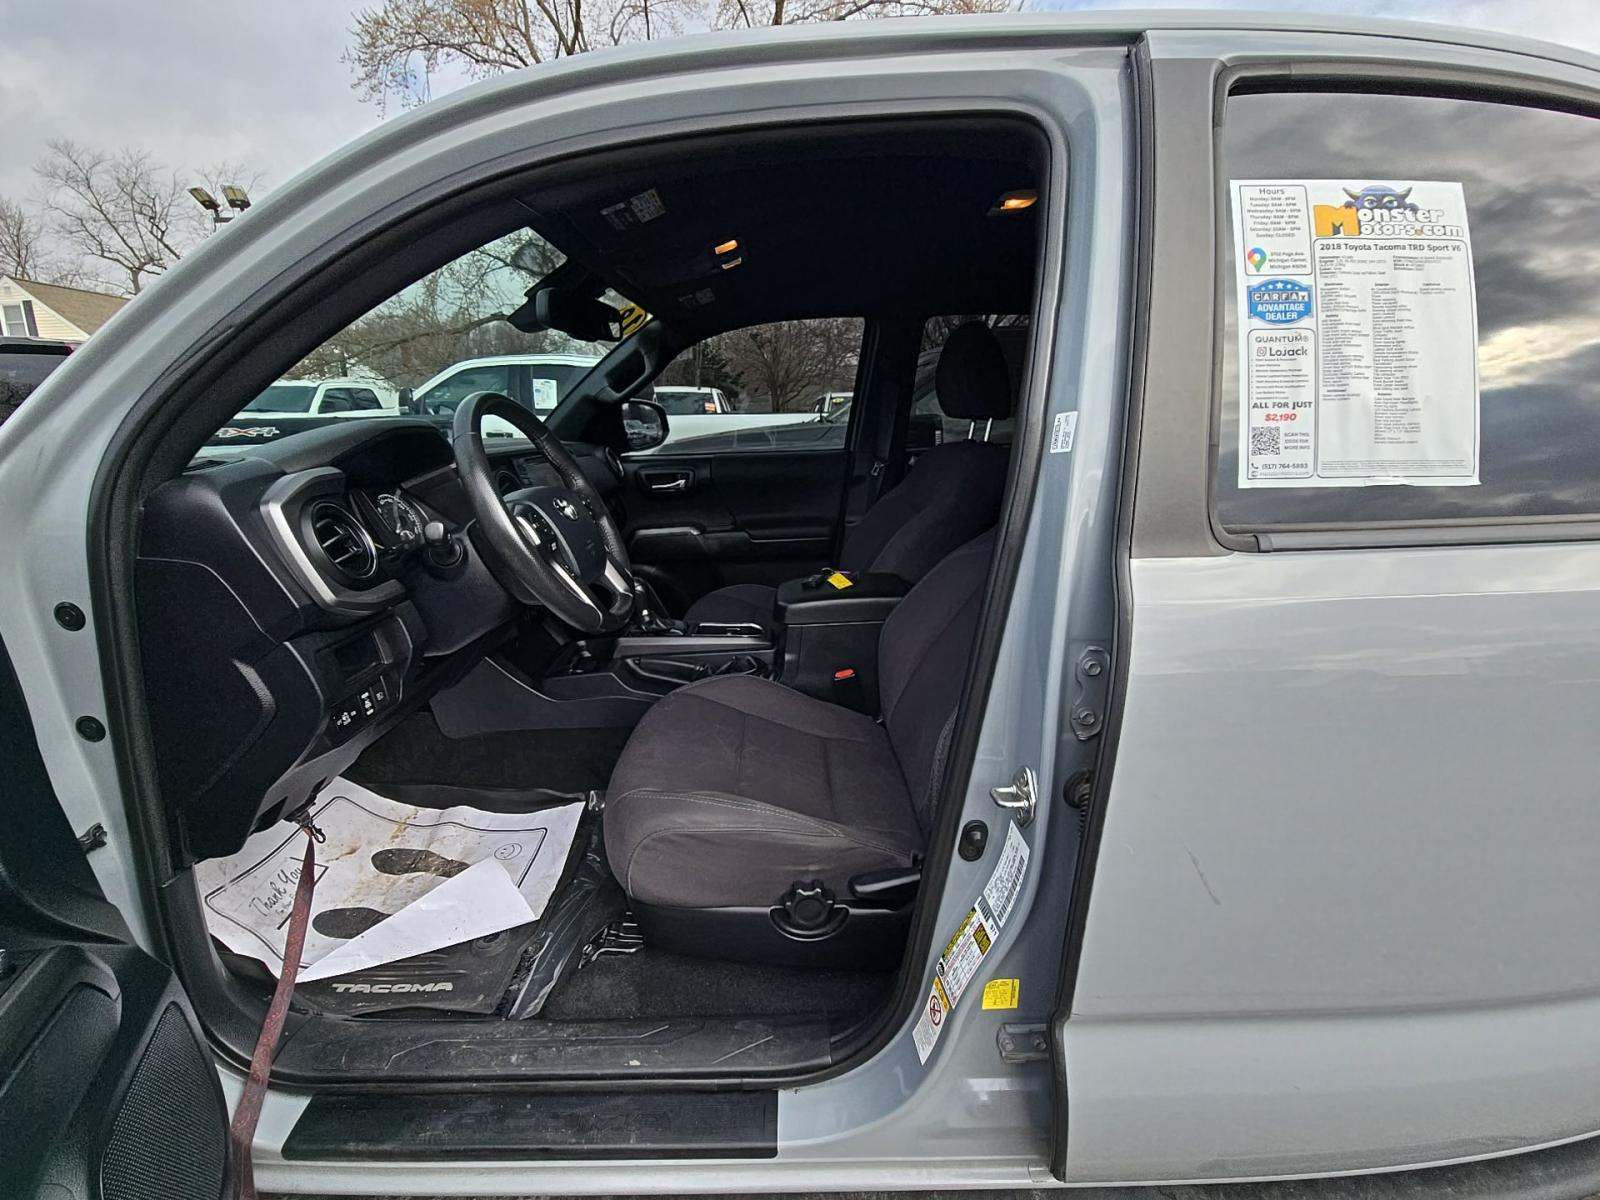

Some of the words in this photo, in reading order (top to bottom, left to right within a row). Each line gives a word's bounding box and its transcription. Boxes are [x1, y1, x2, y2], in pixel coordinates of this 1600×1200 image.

[1319, 243, 1342, 251] 2018
[1344, 243, 1372, 252] Toyota
[1373, 243, 1407, 251] Tacoma
[1407, 243, 1426, 251] TRD
[1427, 244, 1450, 253] Sport
[1253, 291, 1308, 302] CARFAX
[1257, 303, 1305, 312] ADVANTAGE
[1265, 311, 1298, 321] DEALER
[1252, 401, 1270, 409] ALL
[1272, 401, 1290, 409] FOR
[1292, 401, 1313, 410] JUST
[331, 982, 454, 994] TACOMA
